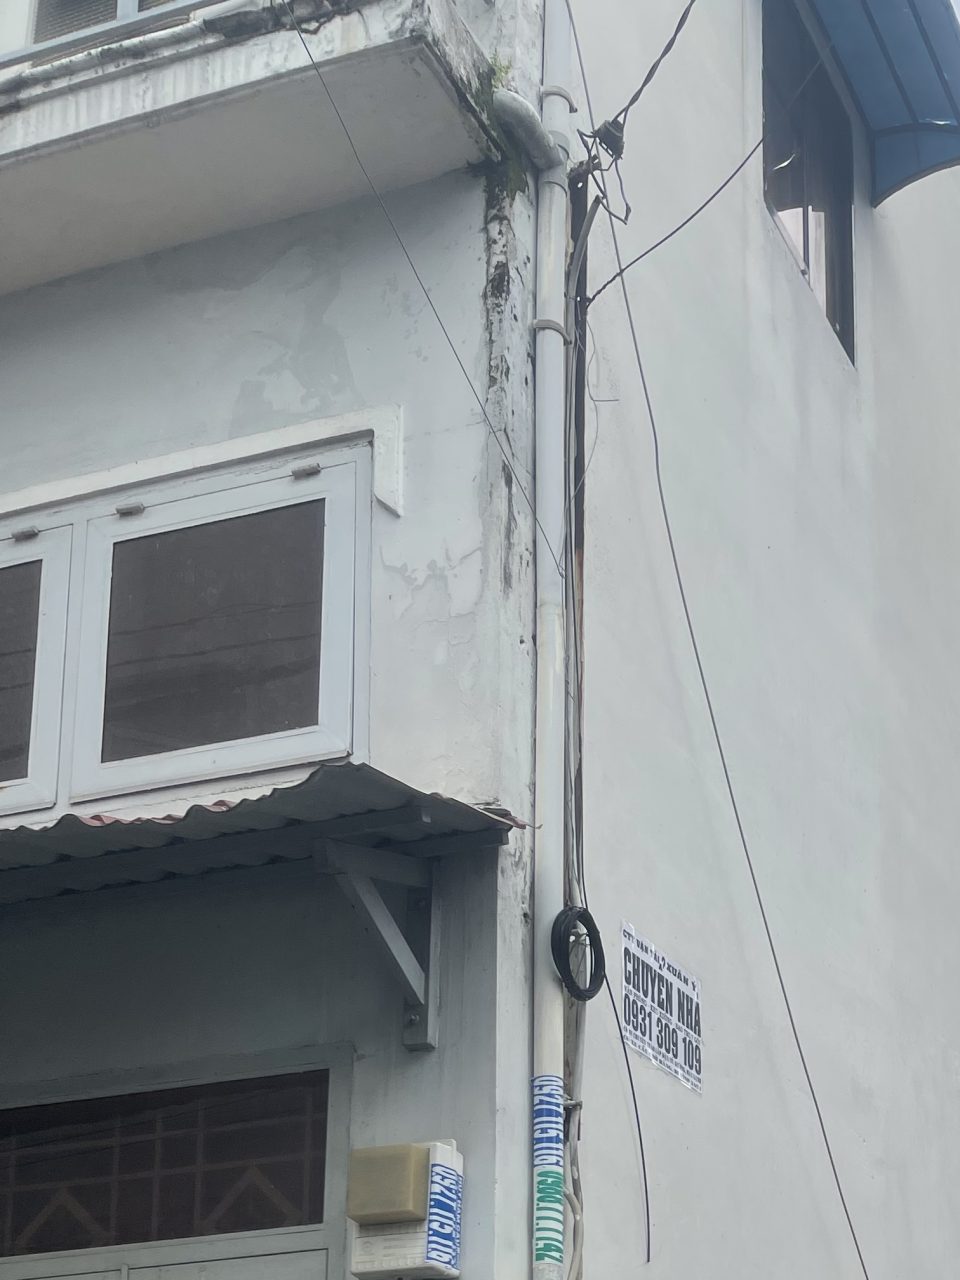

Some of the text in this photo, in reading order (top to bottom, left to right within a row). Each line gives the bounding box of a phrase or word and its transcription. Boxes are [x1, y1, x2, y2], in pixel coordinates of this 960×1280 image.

[624, 946, 673, 1018] CHUYỂN
[624, 993, 653, 1042] 0931
[656, 1017, 678, 1060] 309
[683, 1036, 701, 1075] 109
